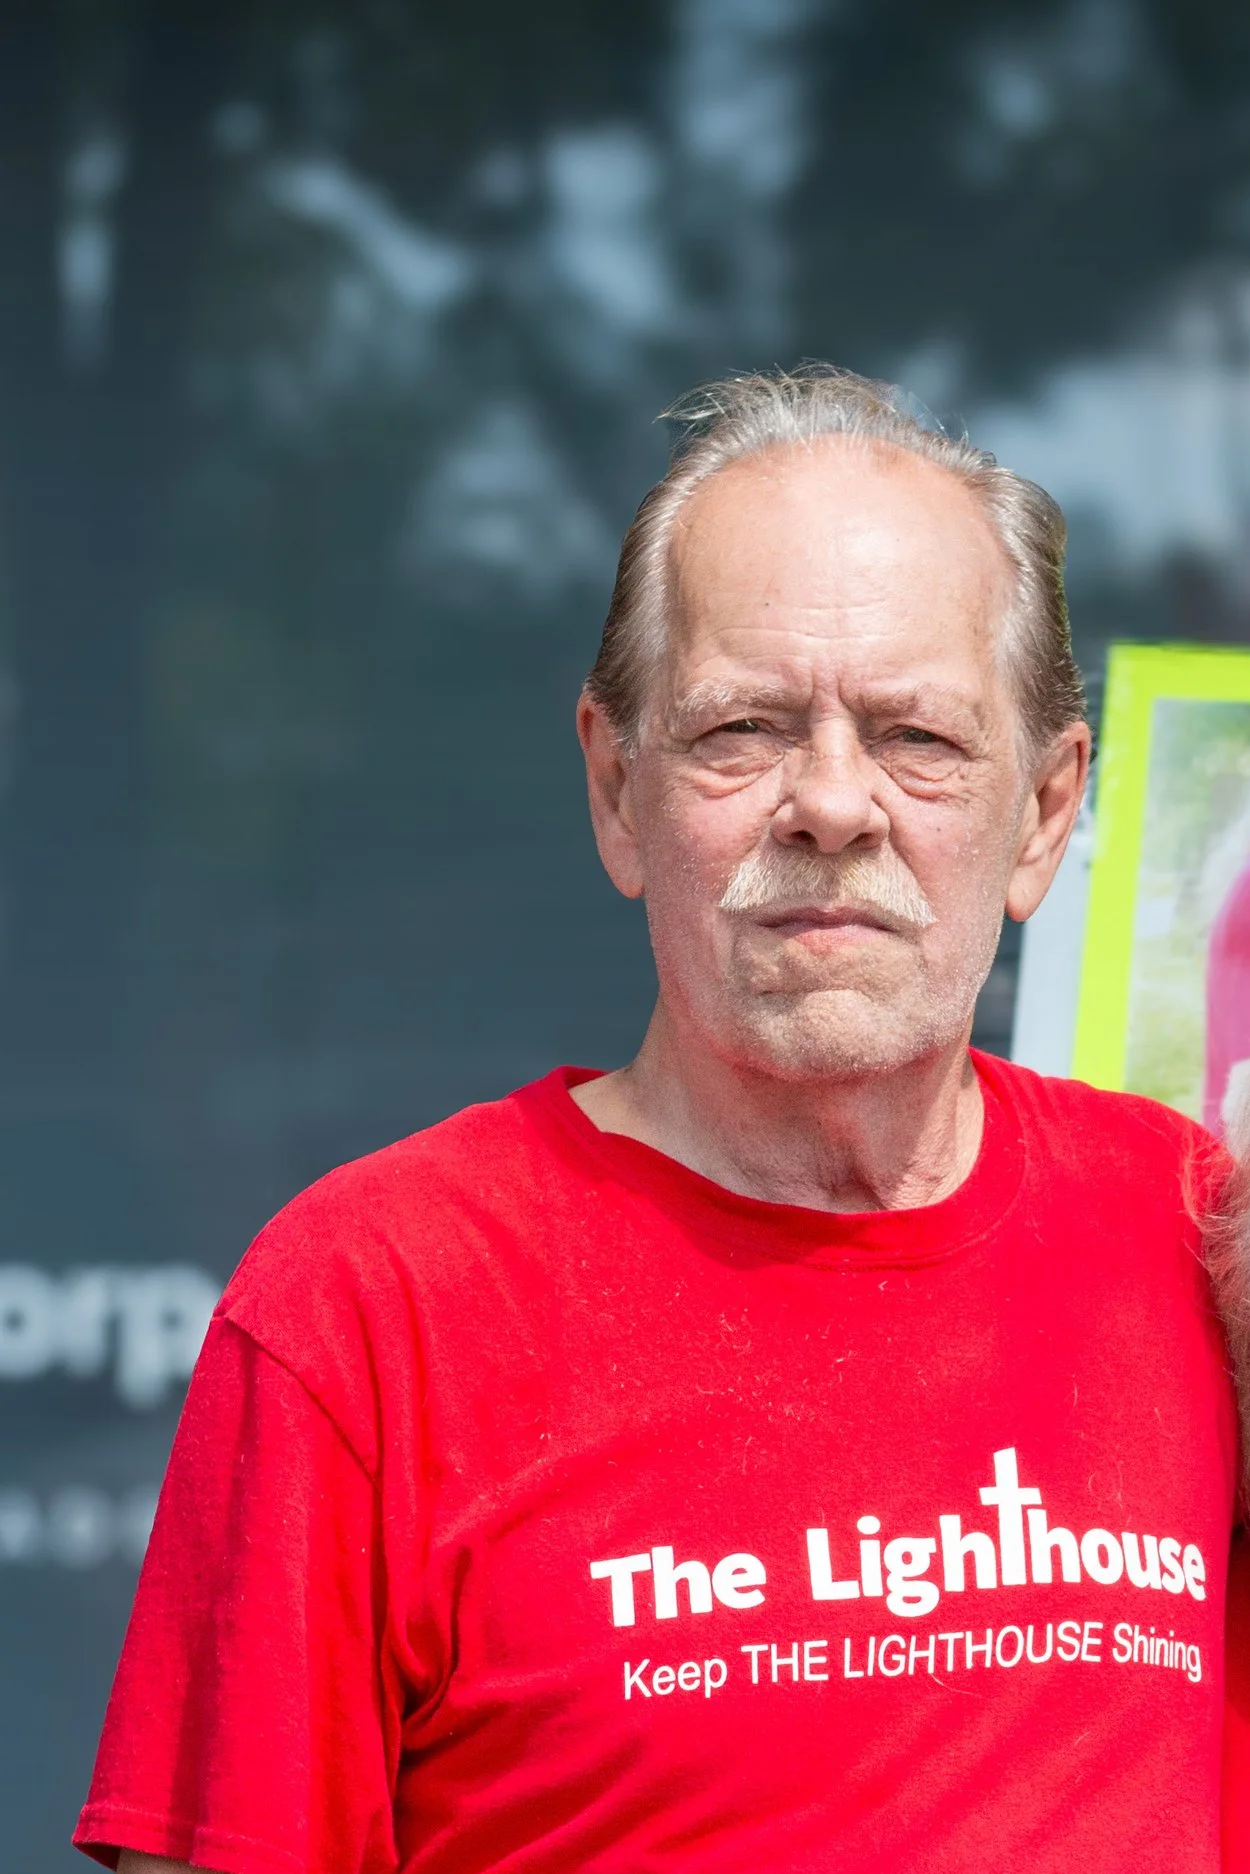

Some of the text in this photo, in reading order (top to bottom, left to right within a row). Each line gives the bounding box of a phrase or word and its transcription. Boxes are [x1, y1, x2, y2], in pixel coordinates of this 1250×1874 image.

[0, 1262, 222, 1410] orp
[590, 1447, 1207, 1627] The Lighthouse
[623, 1621, 1202, 1701] Keep THE LIGHTHOUSE Shining
